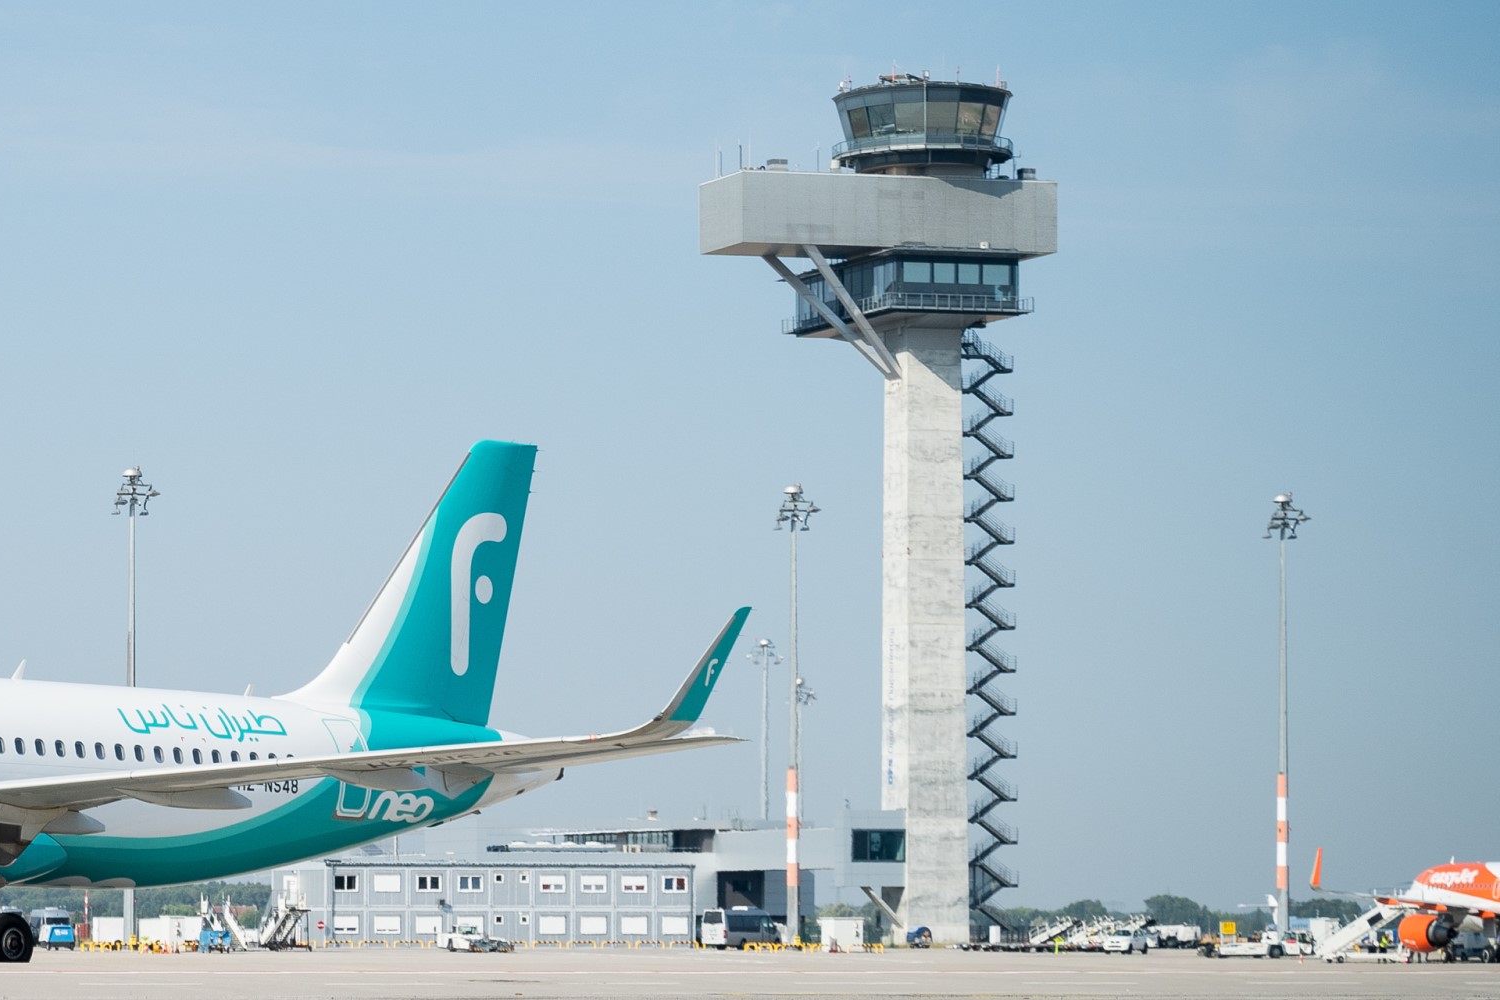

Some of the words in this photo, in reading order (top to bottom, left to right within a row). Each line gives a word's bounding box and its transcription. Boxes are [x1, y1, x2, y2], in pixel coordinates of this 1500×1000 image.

[116, 703, 199, 735] ناس
[199, 706, 288, 743] طيران
[367, 790, 435, 824] neo
